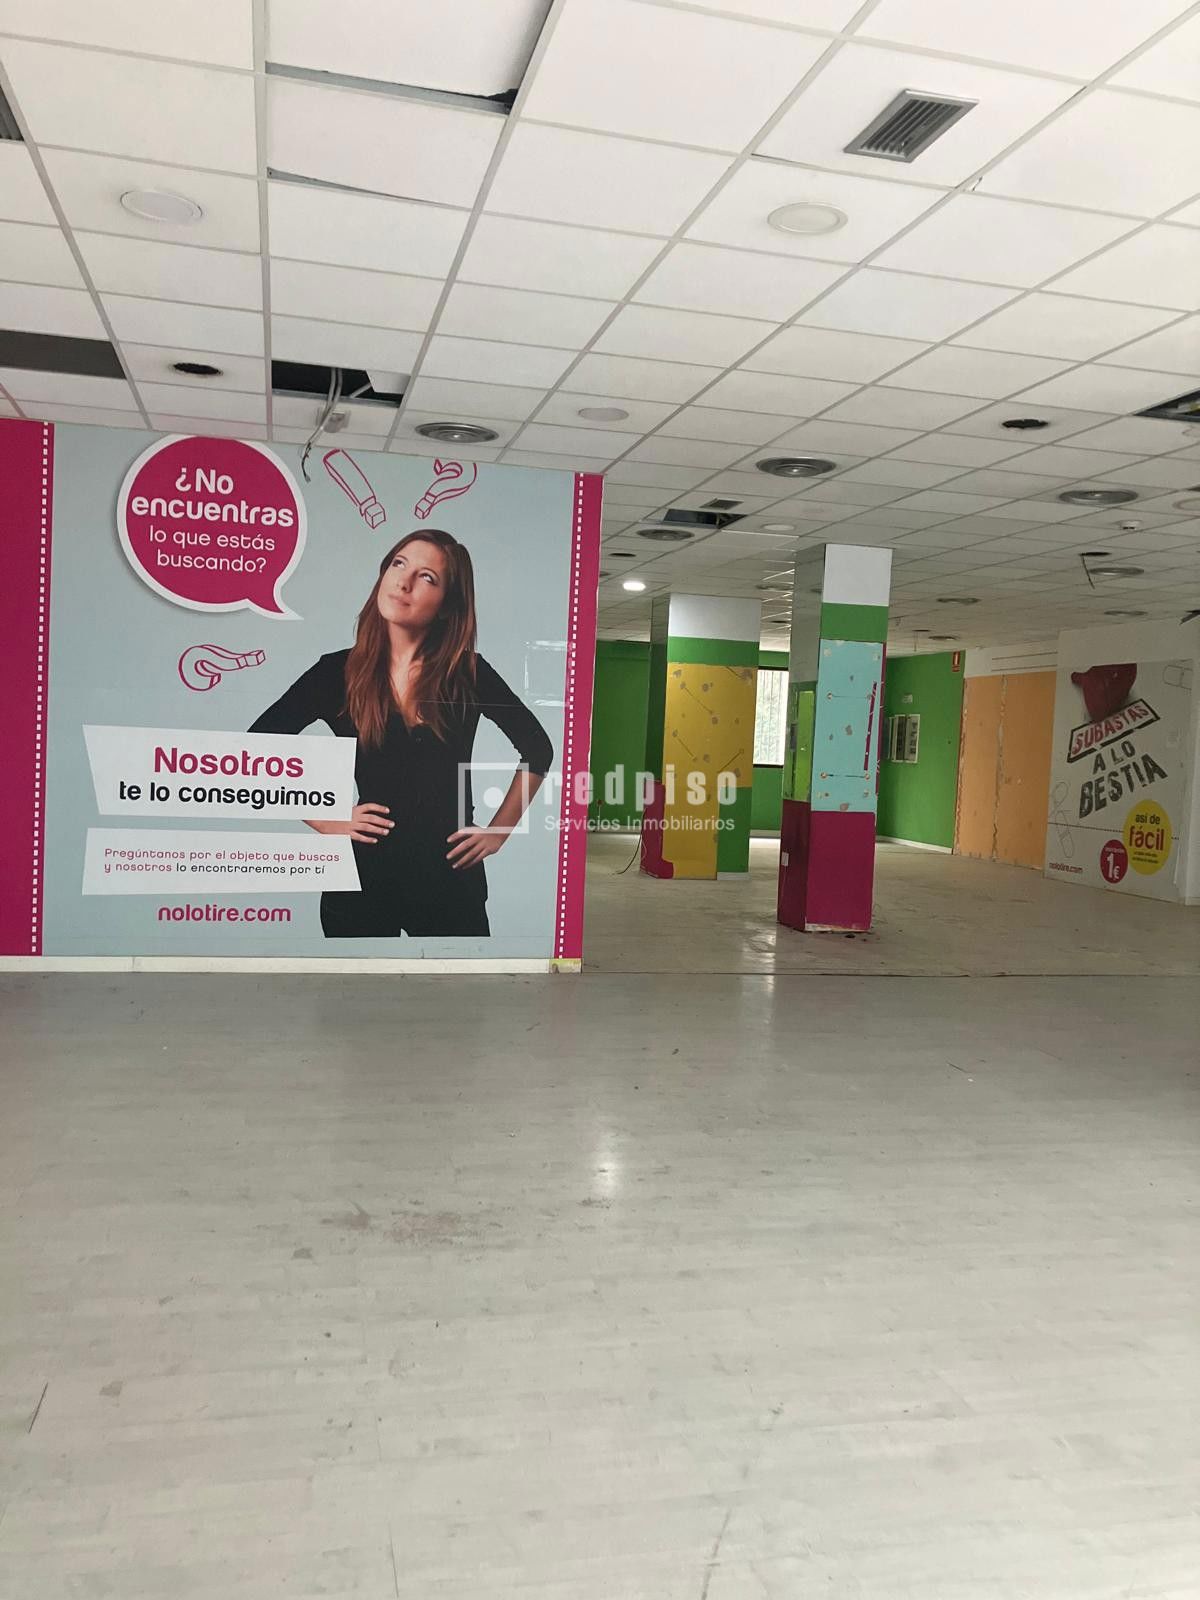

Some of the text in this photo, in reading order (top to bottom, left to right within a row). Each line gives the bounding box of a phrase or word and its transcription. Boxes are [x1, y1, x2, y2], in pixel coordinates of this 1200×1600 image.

[175, 467, 234, 495] ¿No
[131, 496, 295, 528] encuentras
[149, 525, 276, 551] lo que estás
[156, 549, 267, 573] buscando?
[1071, 705, 1149, 755] SUBASTAS
[154, 746, 304, 778] Nosotros
[1092, 740, 1136, 775] A LO
[119, 781, 336, 810] te lo conseguimos
[1079, 753, 1168, 819] BESTIA
[1135, 813, 1160, 825] así de
[1129, 825, 1164, 851] fácil
[104, 848, 340, 863] Pregúntanos por el objeto que buscas
[104, 863, 112, 873] y
[115, 863, 173, 872] nosotros
[176, 863, 188, 873] lo
[190, 865, 287, 875] encontraremos
[289, 866, 312, 876] por
[158, 904, 292, 923] nolotire.com
